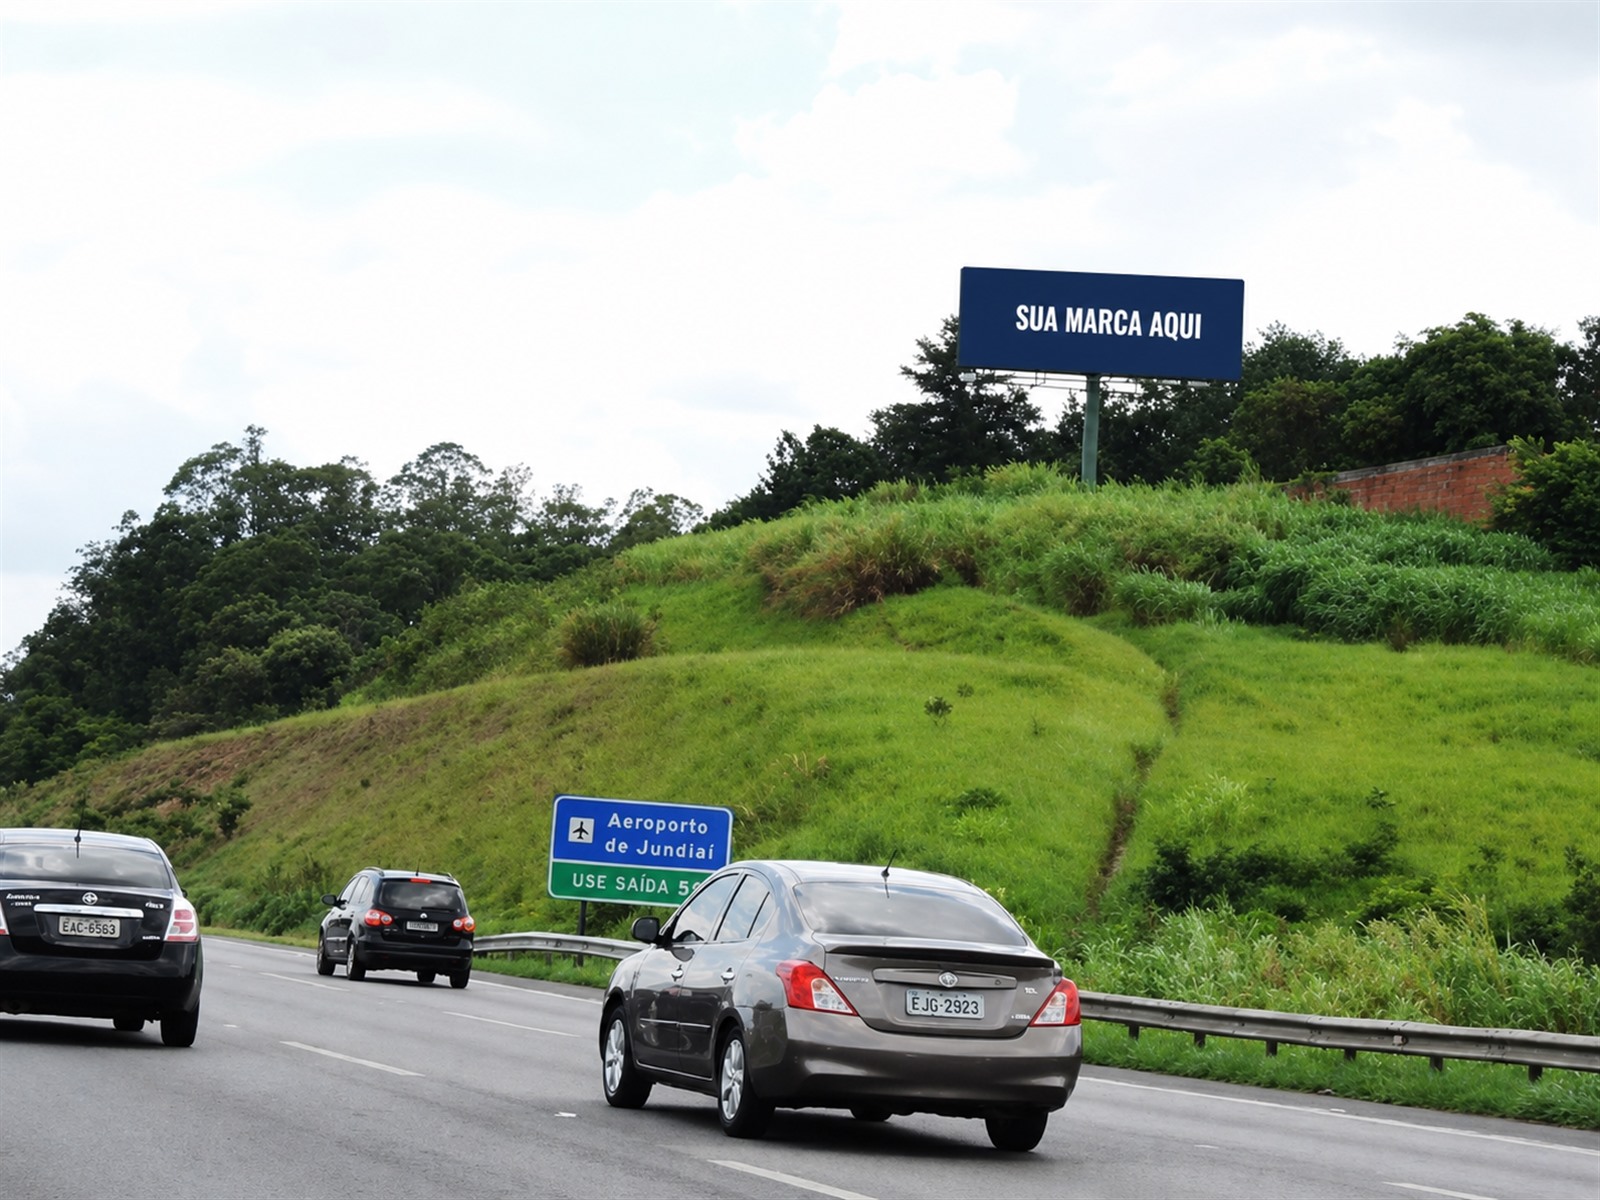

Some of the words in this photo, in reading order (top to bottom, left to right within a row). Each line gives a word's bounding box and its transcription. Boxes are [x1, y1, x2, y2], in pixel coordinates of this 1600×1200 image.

[1015, 304, 1058, 332] SUA
[1065, 307, 1142, 336] MARCA
[1149, 311, 1202, 341] AQUI
[607, 812, 708, 834] Aeroporto
[605, 838, 628, 853] de
[636, 839, 714, 860] Jundiaí
[572, 873, 607, 889] USE
[615, 873, 669, 894] SAÍDA
[911, 996, 979, 1015] EJG-2923
